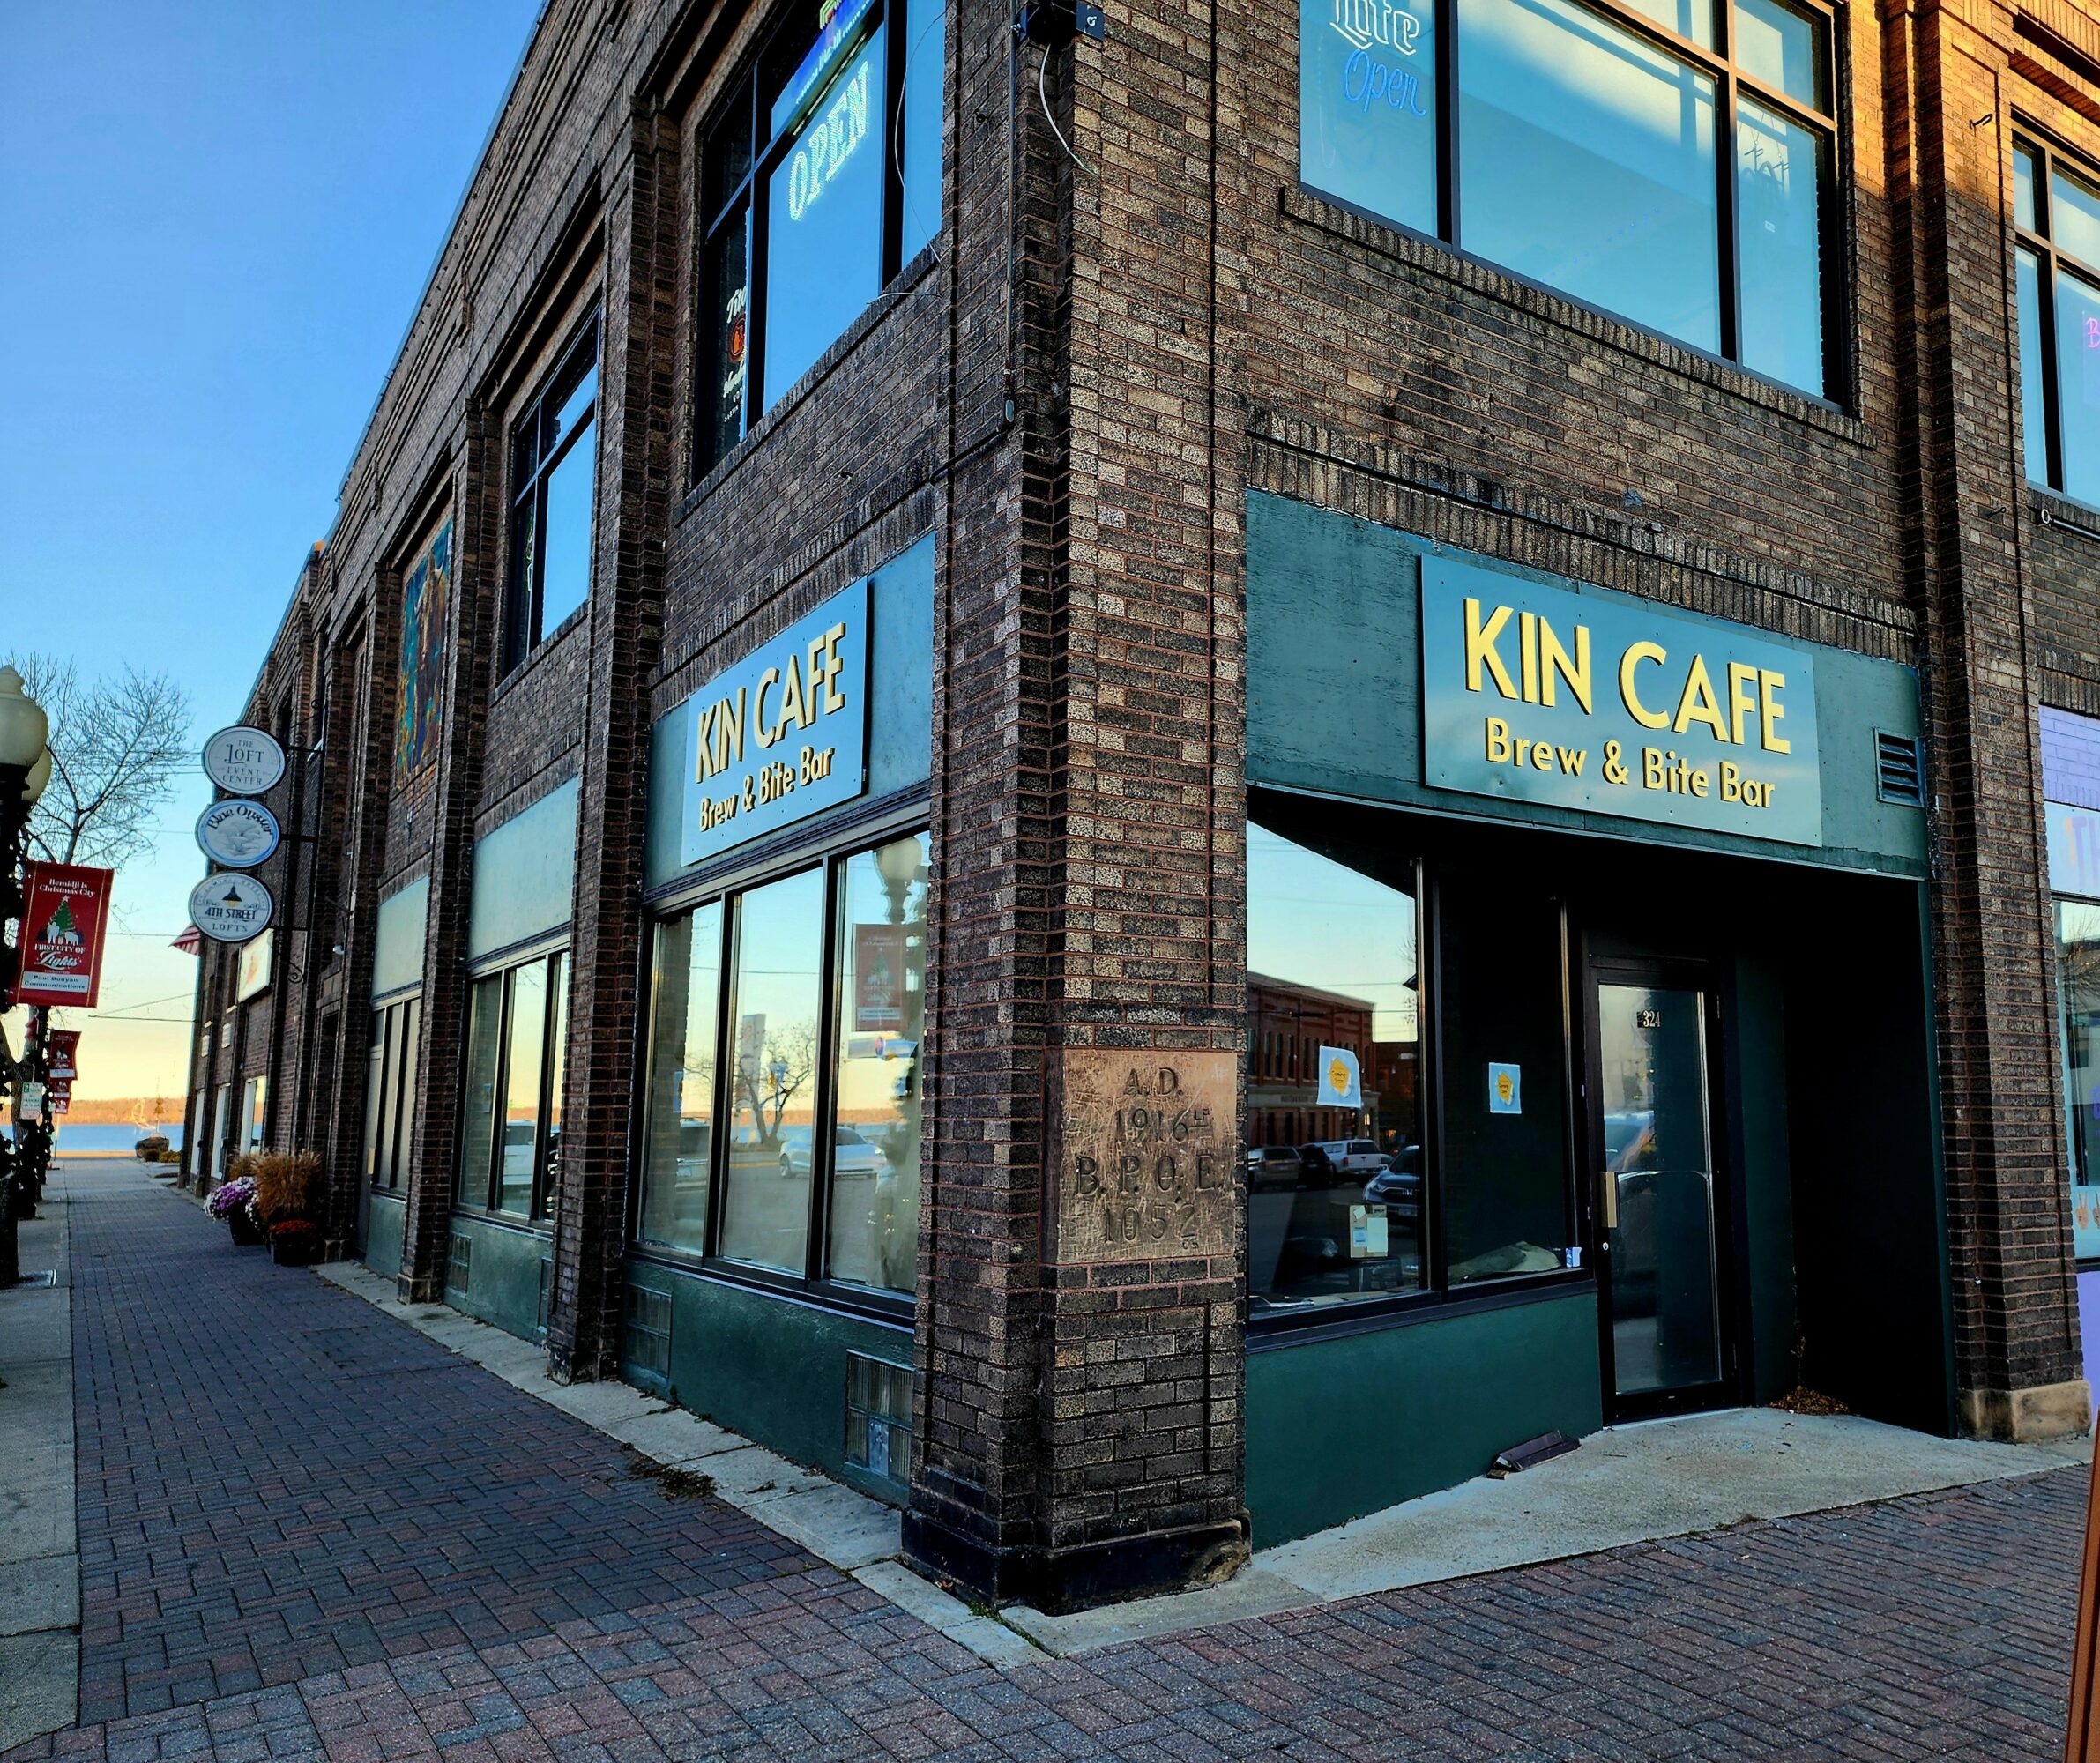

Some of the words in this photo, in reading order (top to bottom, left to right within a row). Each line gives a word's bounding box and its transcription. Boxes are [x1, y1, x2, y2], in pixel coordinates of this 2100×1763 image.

[1344, 48, 1426, 116] Open
[789, 61, 869, 220] OPEN
[1463, 597, 1593, 715] KIN
[1619, 640, 1791, 755] CAFE
[696, 687, 747, 784] KIN
[754, 621, 846, 748] CAFE
[224, 743, 264, 765] LOFT
[1485, 716, 1587, 777] Brew
[1602, 739, 1629, 785] &
[1642, 747, 1709, 798] Bite
[1719, 761, 1776, 808] Bar
[222, 775, 262, 785] CENTER
[227, 766, 260, 777] EVENT
[699, 794, 739, 832] Brew
[742, 775, 756, 812] &
[759, 762, 796, 805] Bite
[800, 745, 836, 786] Bar
[206, 809, 235, 829] Blue
[39, 883, 78, 896] Christmas
[79, 888, 94, 898] City
[205, 907, 223, 918] 4TH
[226, 908, 257, 919] STREET
[212, 923, 248, 933] LOFTS
[56, 944, 75, 953] CITY
[34, 951, 78, 970] Lights
[1643, 1009, 1661, 1028] 324
[1104, 1201, 1197, 1245] 1052
